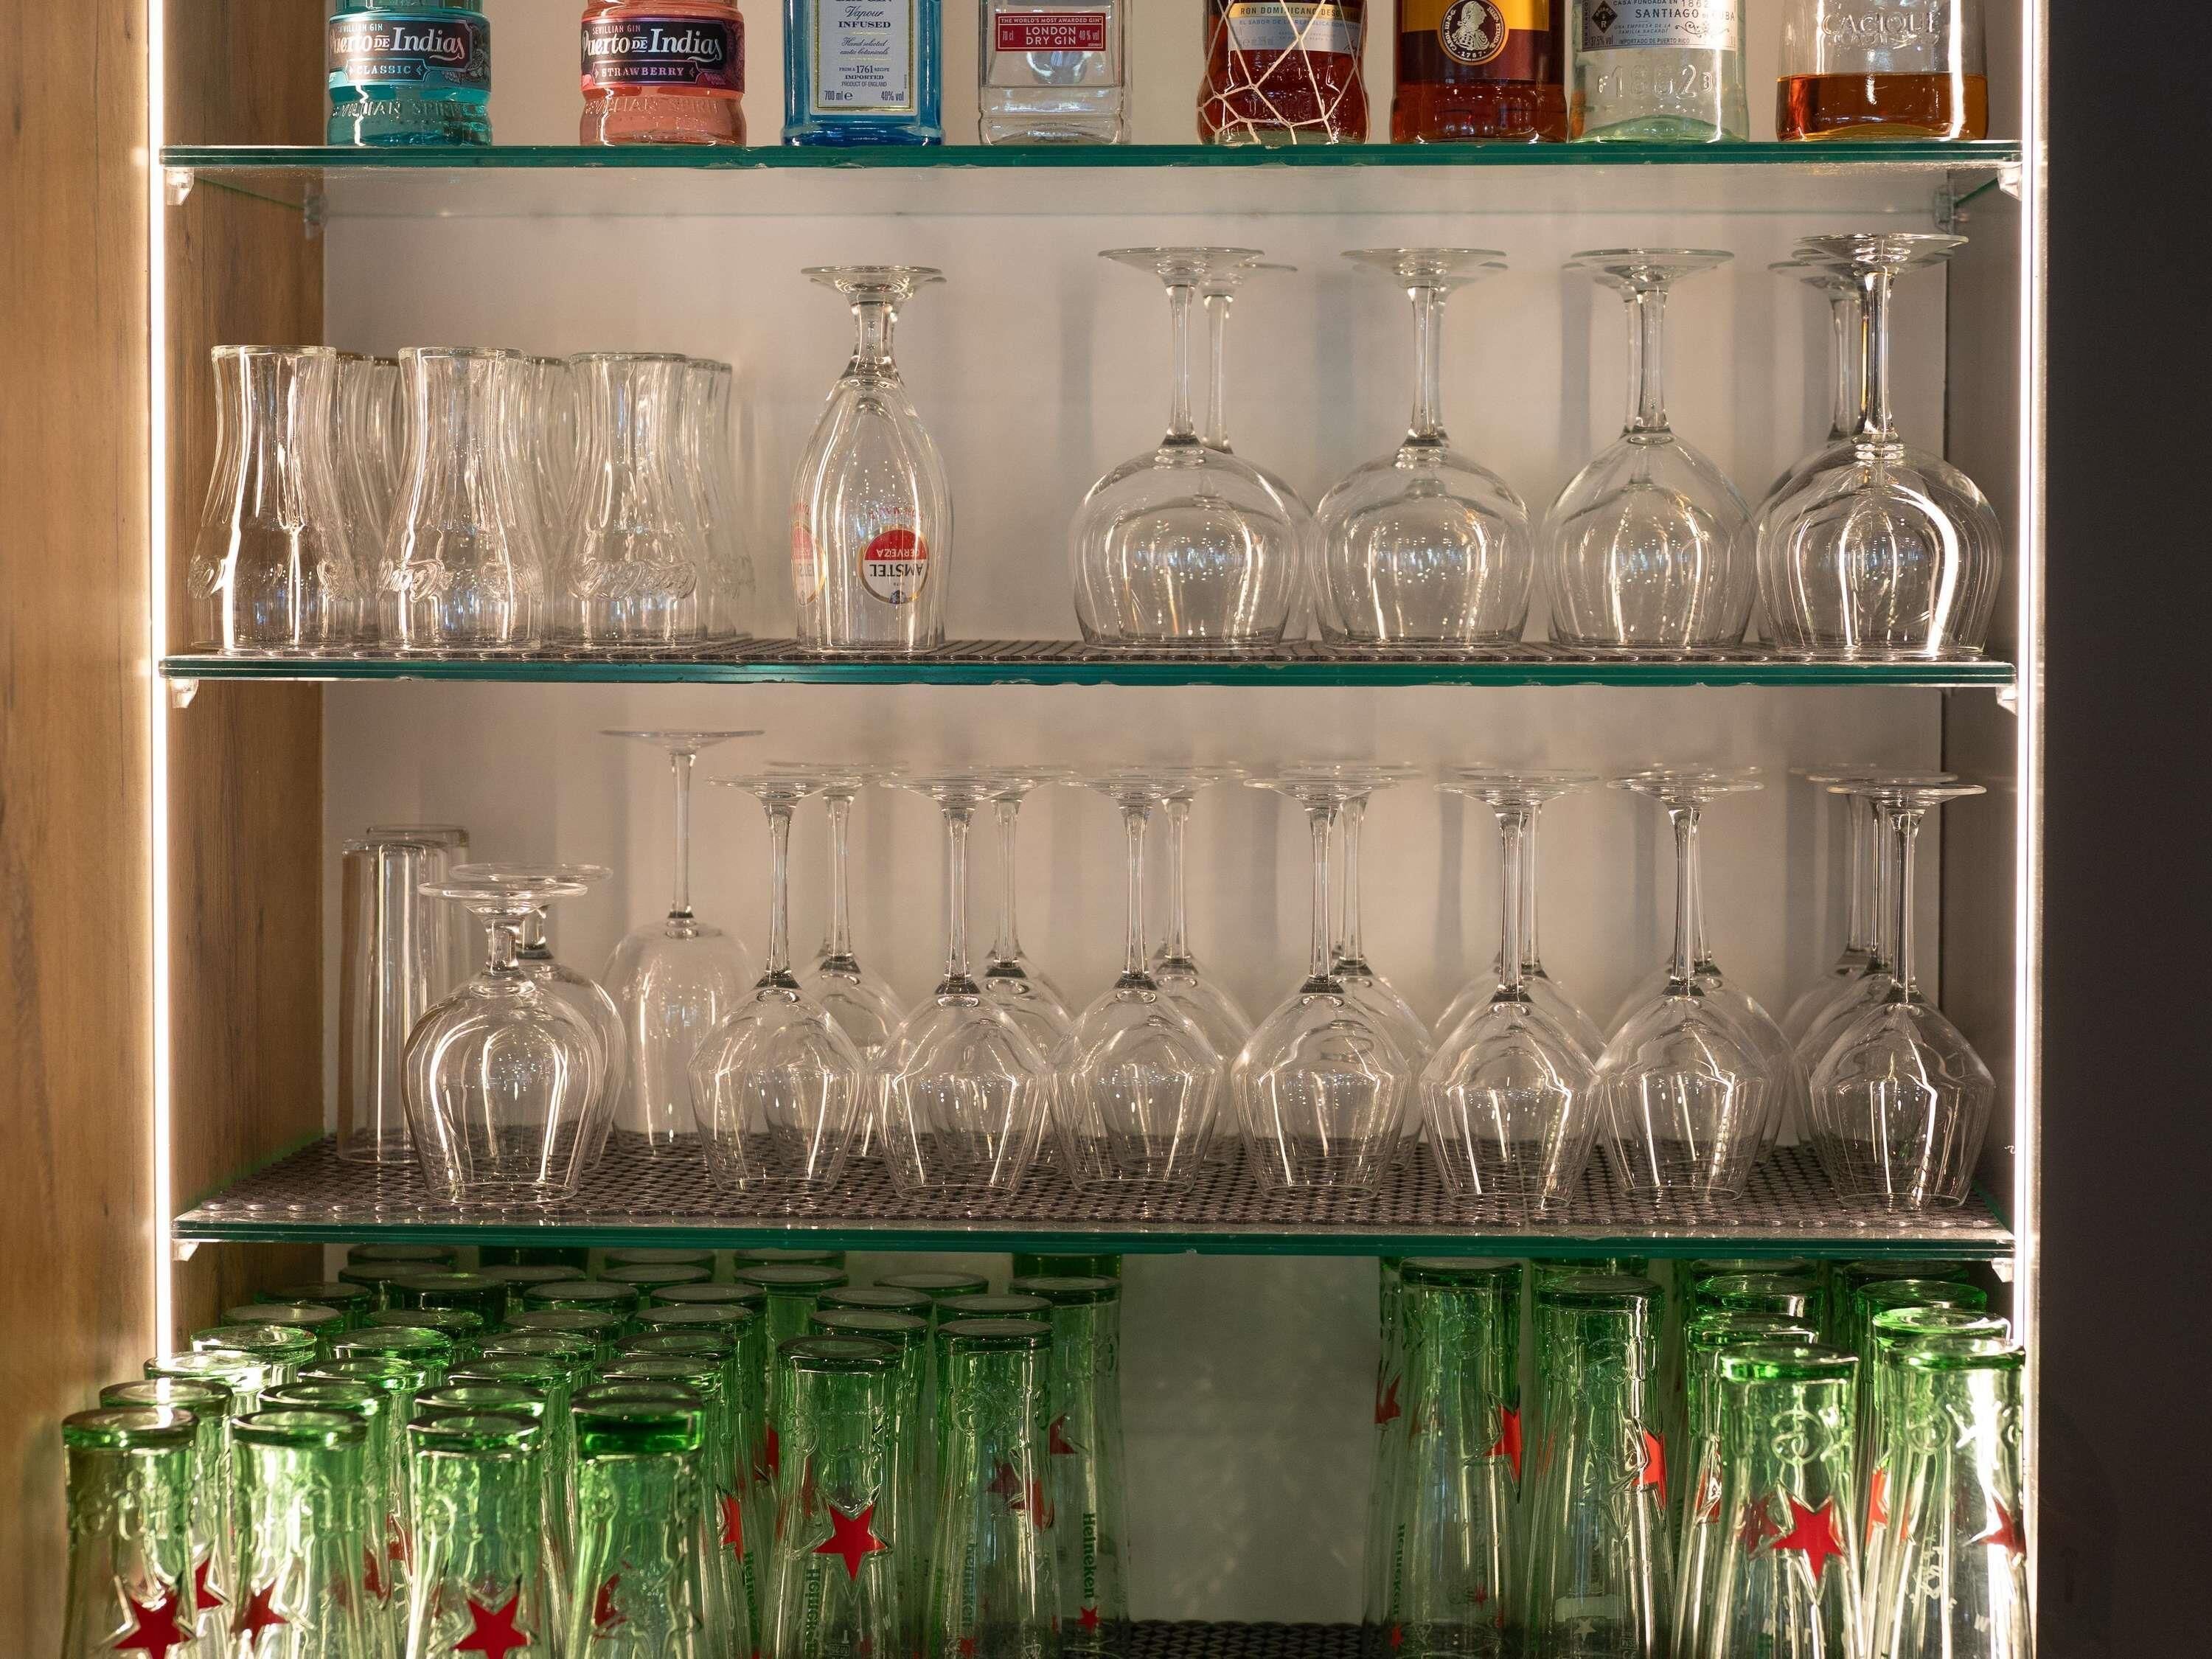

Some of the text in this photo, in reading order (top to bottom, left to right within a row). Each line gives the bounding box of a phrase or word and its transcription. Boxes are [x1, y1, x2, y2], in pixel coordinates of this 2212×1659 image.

[845, 5, 884, 20] Vapour
[1635, 9, 1699, 18] SANTIAGO
[369, 23, 383, 31] GIN
[627, 24, 641, 32] GIN
[1026, 27, 1077, 35] LONDON
[390, 27, 465, 61] Indias
[582, 28, 723, 63] Puerto DE Indias
[1026, 37, 1077, 45] DRY GIN
[357, 65, 411, 74] CLASSIC
[602, 67, 684, 76] STRAWBERRY
[855, 65, 873, 73] 1761
[825, 91, 835, 100] 700
[836, 91, 844, 100] ml
[880, 91, 904, 101] 40% vol
[876, 548, 920, 558] CERVEZA
[869, 563, 924, 577] AMSTEL
[1082, 1512, 1098, 1599] Heineken
